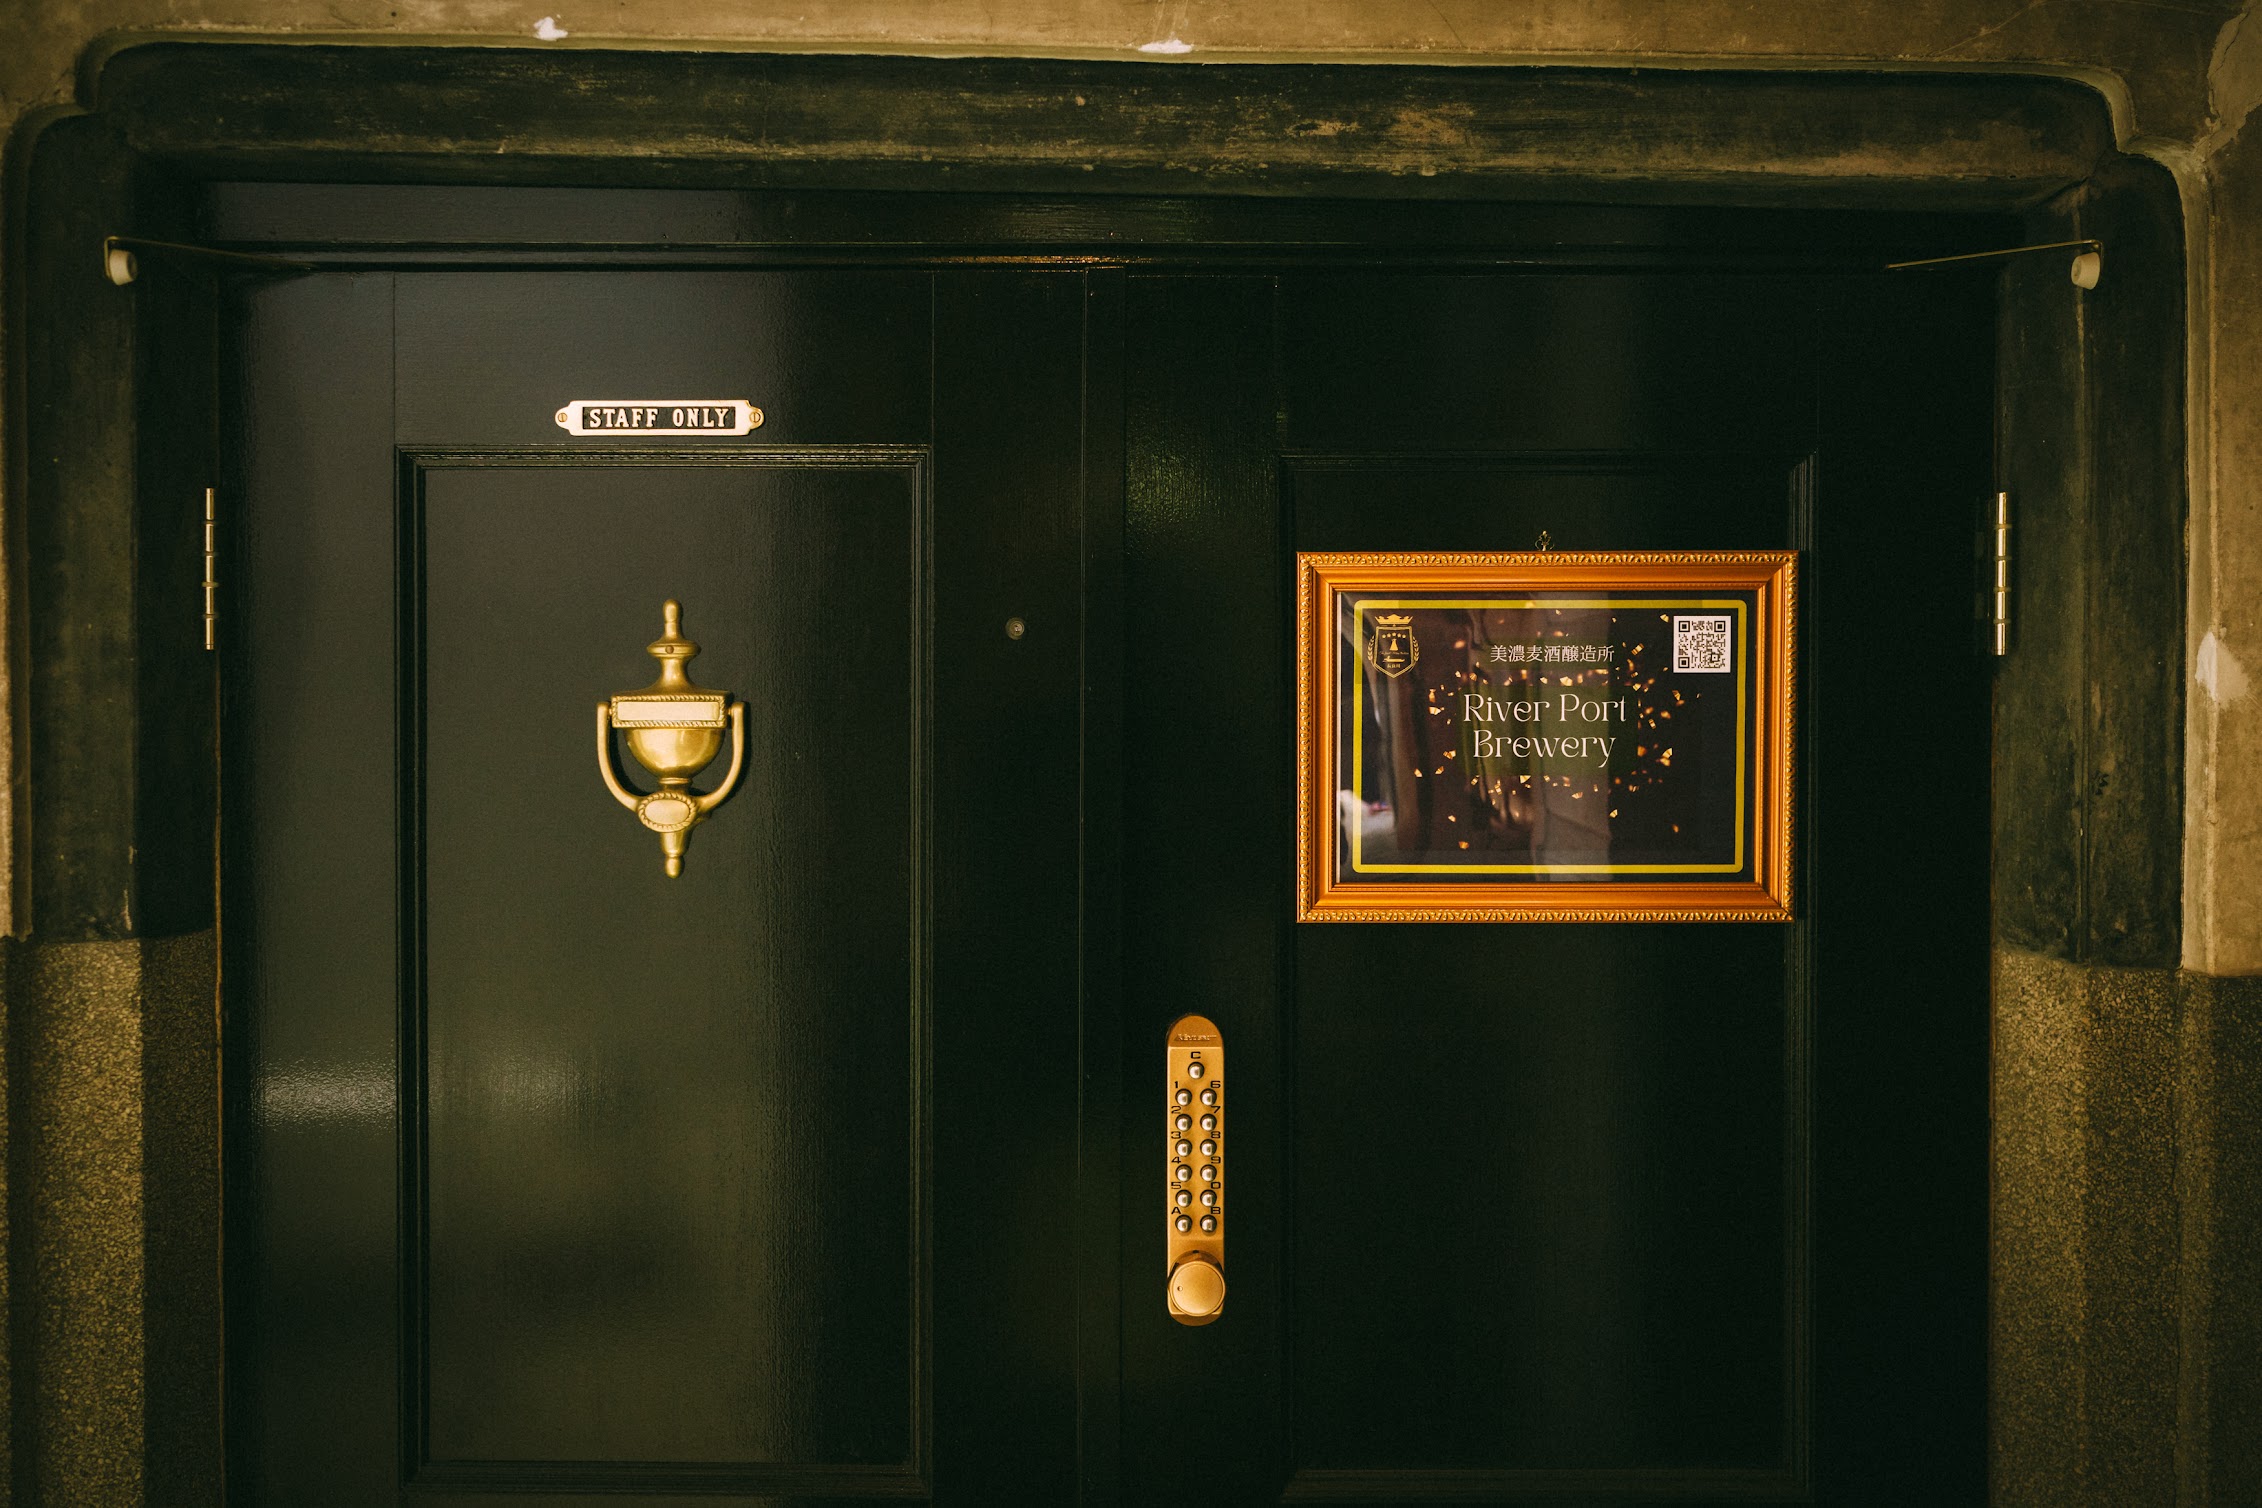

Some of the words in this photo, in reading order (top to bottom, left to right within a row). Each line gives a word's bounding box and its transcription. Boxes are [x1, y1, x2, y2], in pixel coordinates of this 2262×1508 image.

[589, 408, 659, 428] STAFF
[672, 408, 729, 428] ONLY
[1463, 693, 1550, 722] River
[1559, 693, 1626, 722] Port
[1473, 729, 1616, 768] Brewery
[1190, 1051, 1201, 1059] C
[1171, 1105, 1181, 1114] 2
[1210, 1105, 1221, 1114] 7
[1171, 1131, 1181, 1139] 3
[1210, 1131, 1221, 1139] 8
[1171, 1156, 1181, 1164] 4
[1210, 1156, 1221, 1164] 9
[1171, 1181, 1181, 1189] 5
[1210, 1181, 1221, 1189] 0
[1171, 1206, 1181, 1214] A
[1210, 1206, 1221, 1214] B
